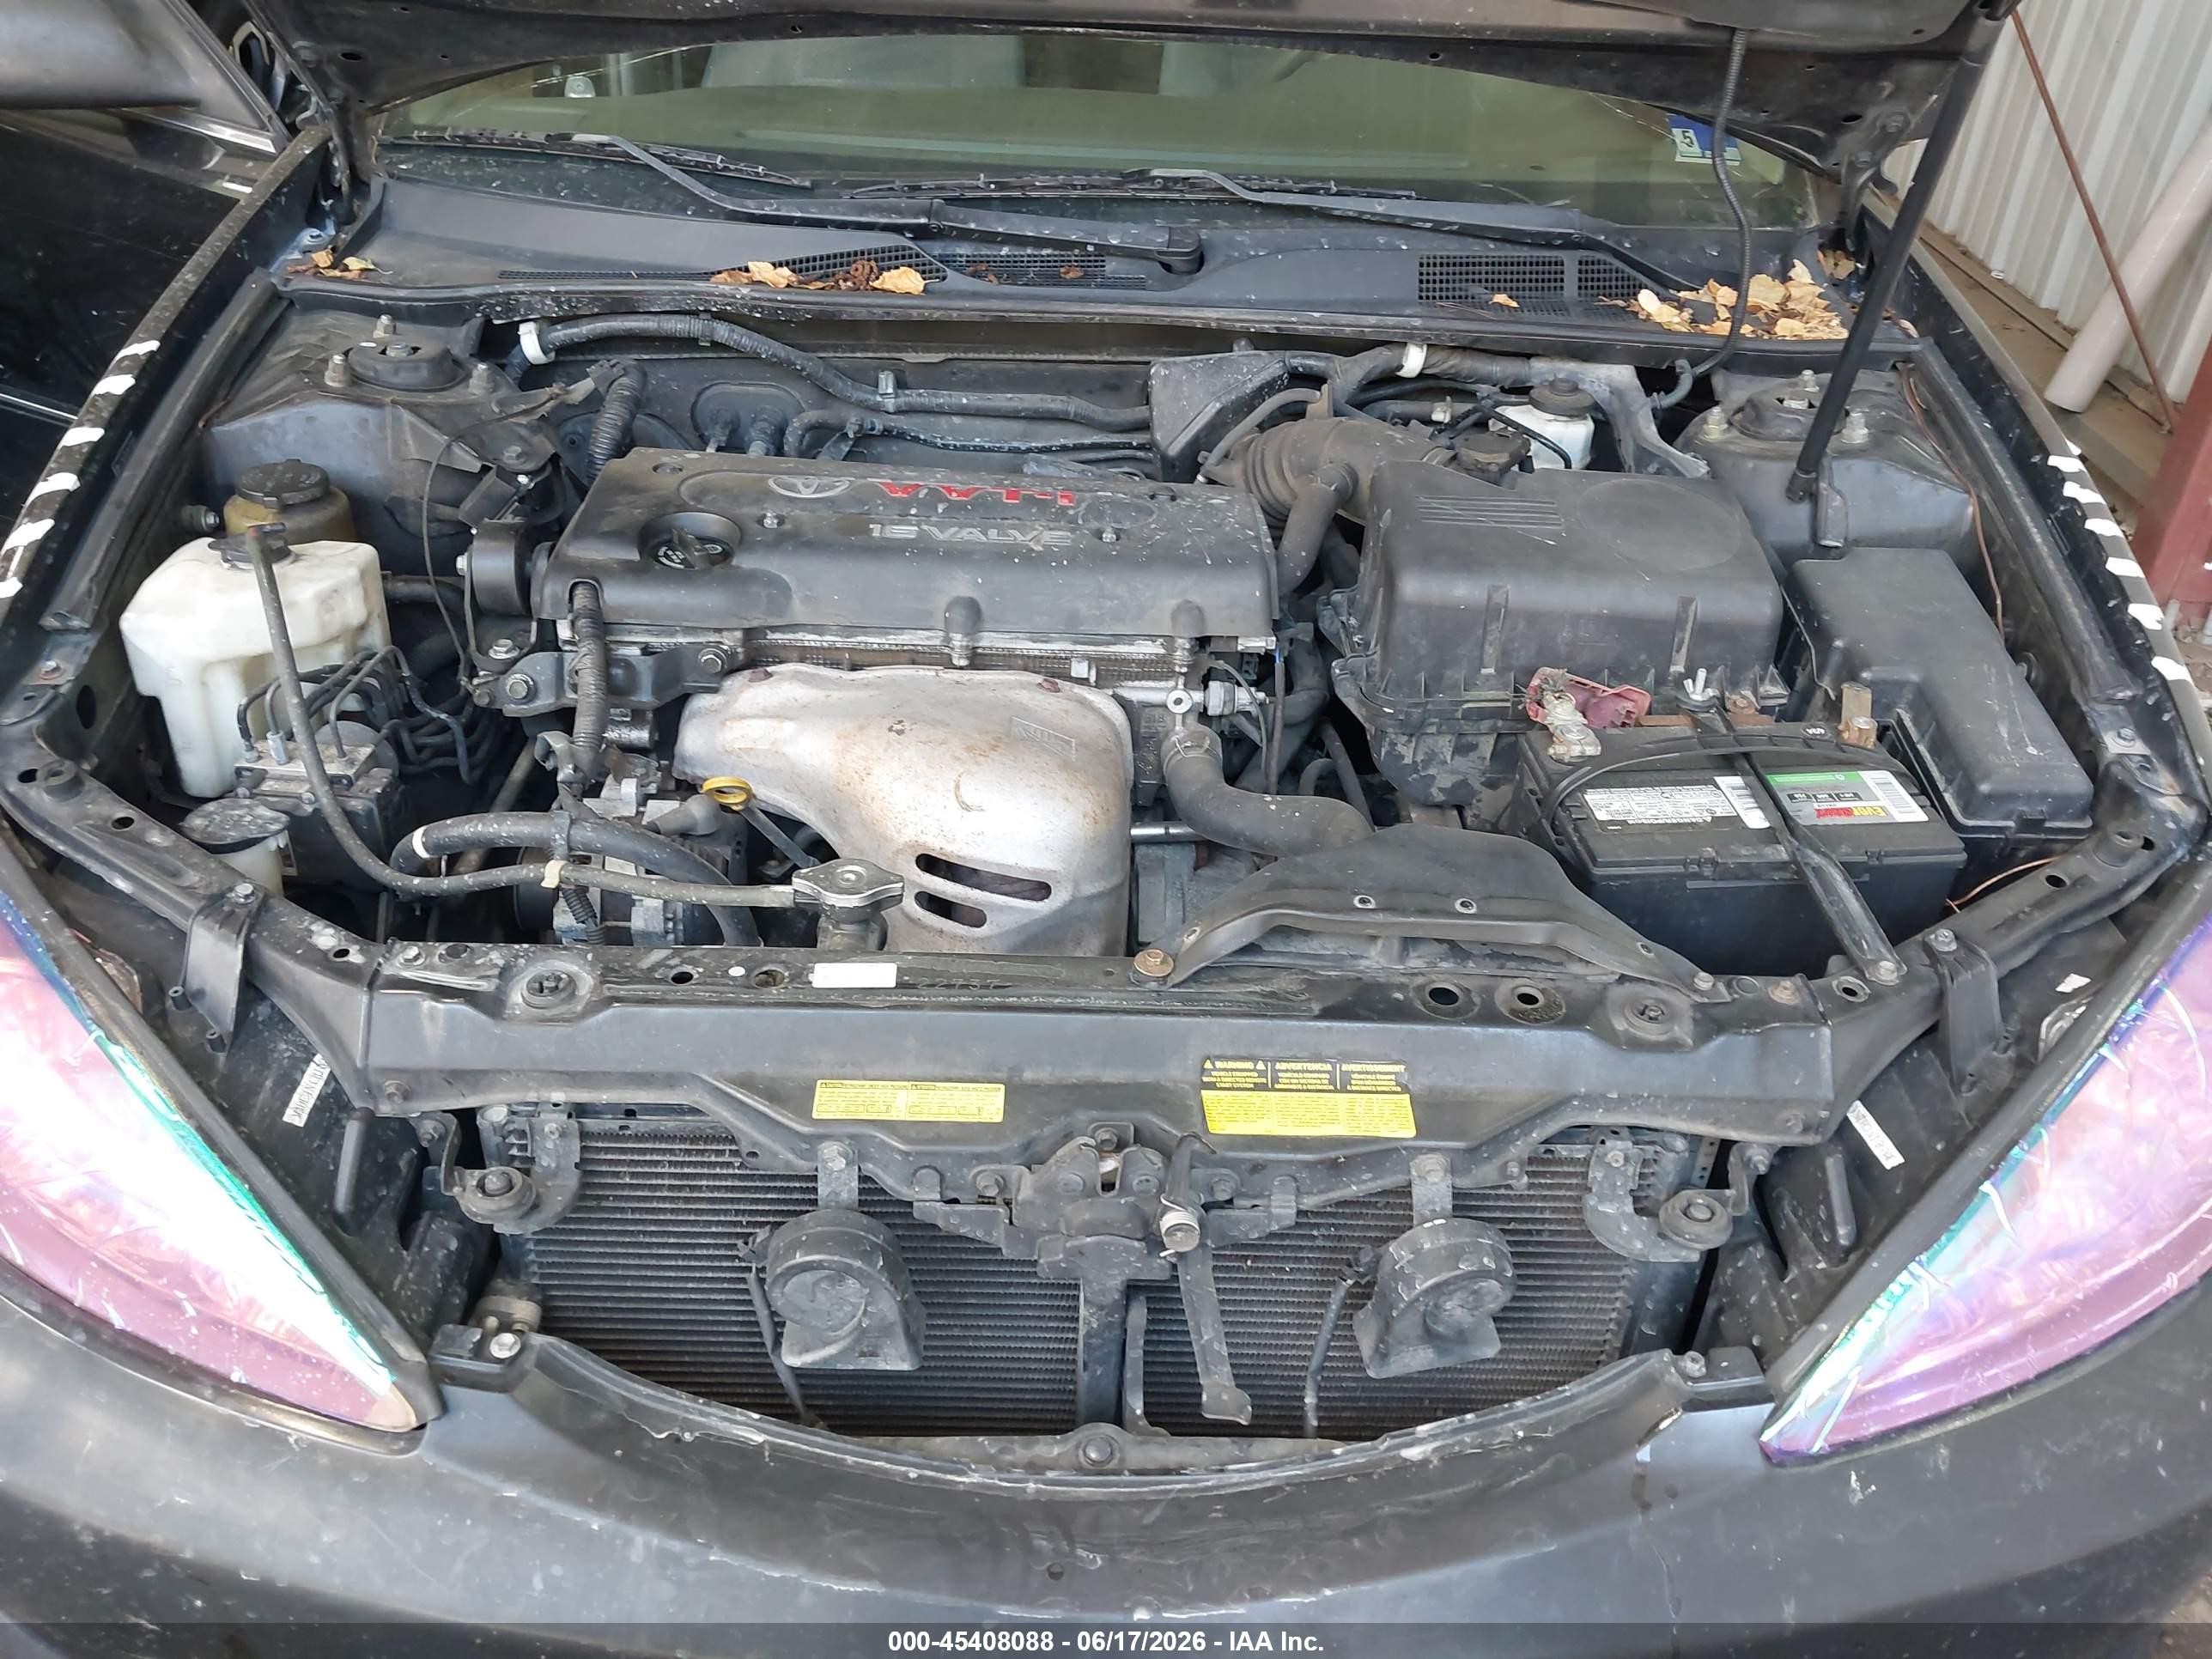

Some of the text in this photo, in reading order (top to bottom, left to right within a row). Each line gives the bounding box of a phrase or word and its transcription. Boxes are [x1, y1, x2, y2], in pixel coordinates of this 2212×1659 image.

[1680, 130, 1695, 149] 5
[869, 523, 1072, 547] 16 VALVE
